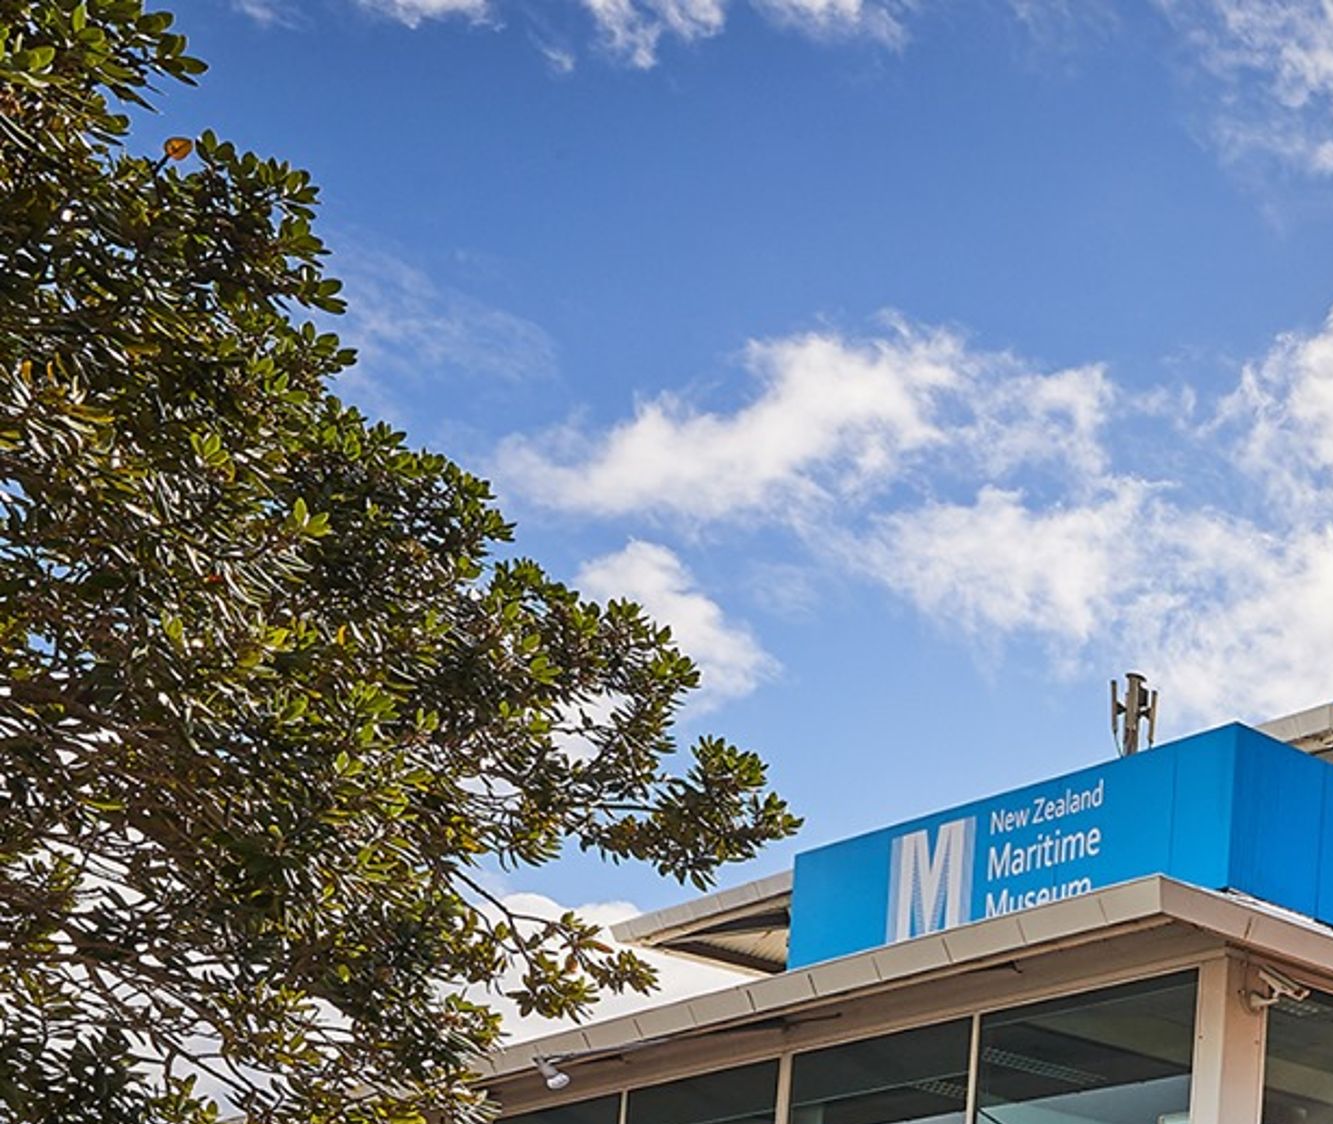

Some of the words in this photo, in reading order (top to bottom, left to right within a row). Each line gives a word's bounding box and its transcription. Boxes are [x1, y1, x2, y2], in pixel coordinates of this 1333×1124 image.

[990, 810, 1029, 835] New
[1033, 778, 1104, 824] Zealand
[987, 827, 1101, 882] Maritime
[985, 877, 1092, 920] Museum
